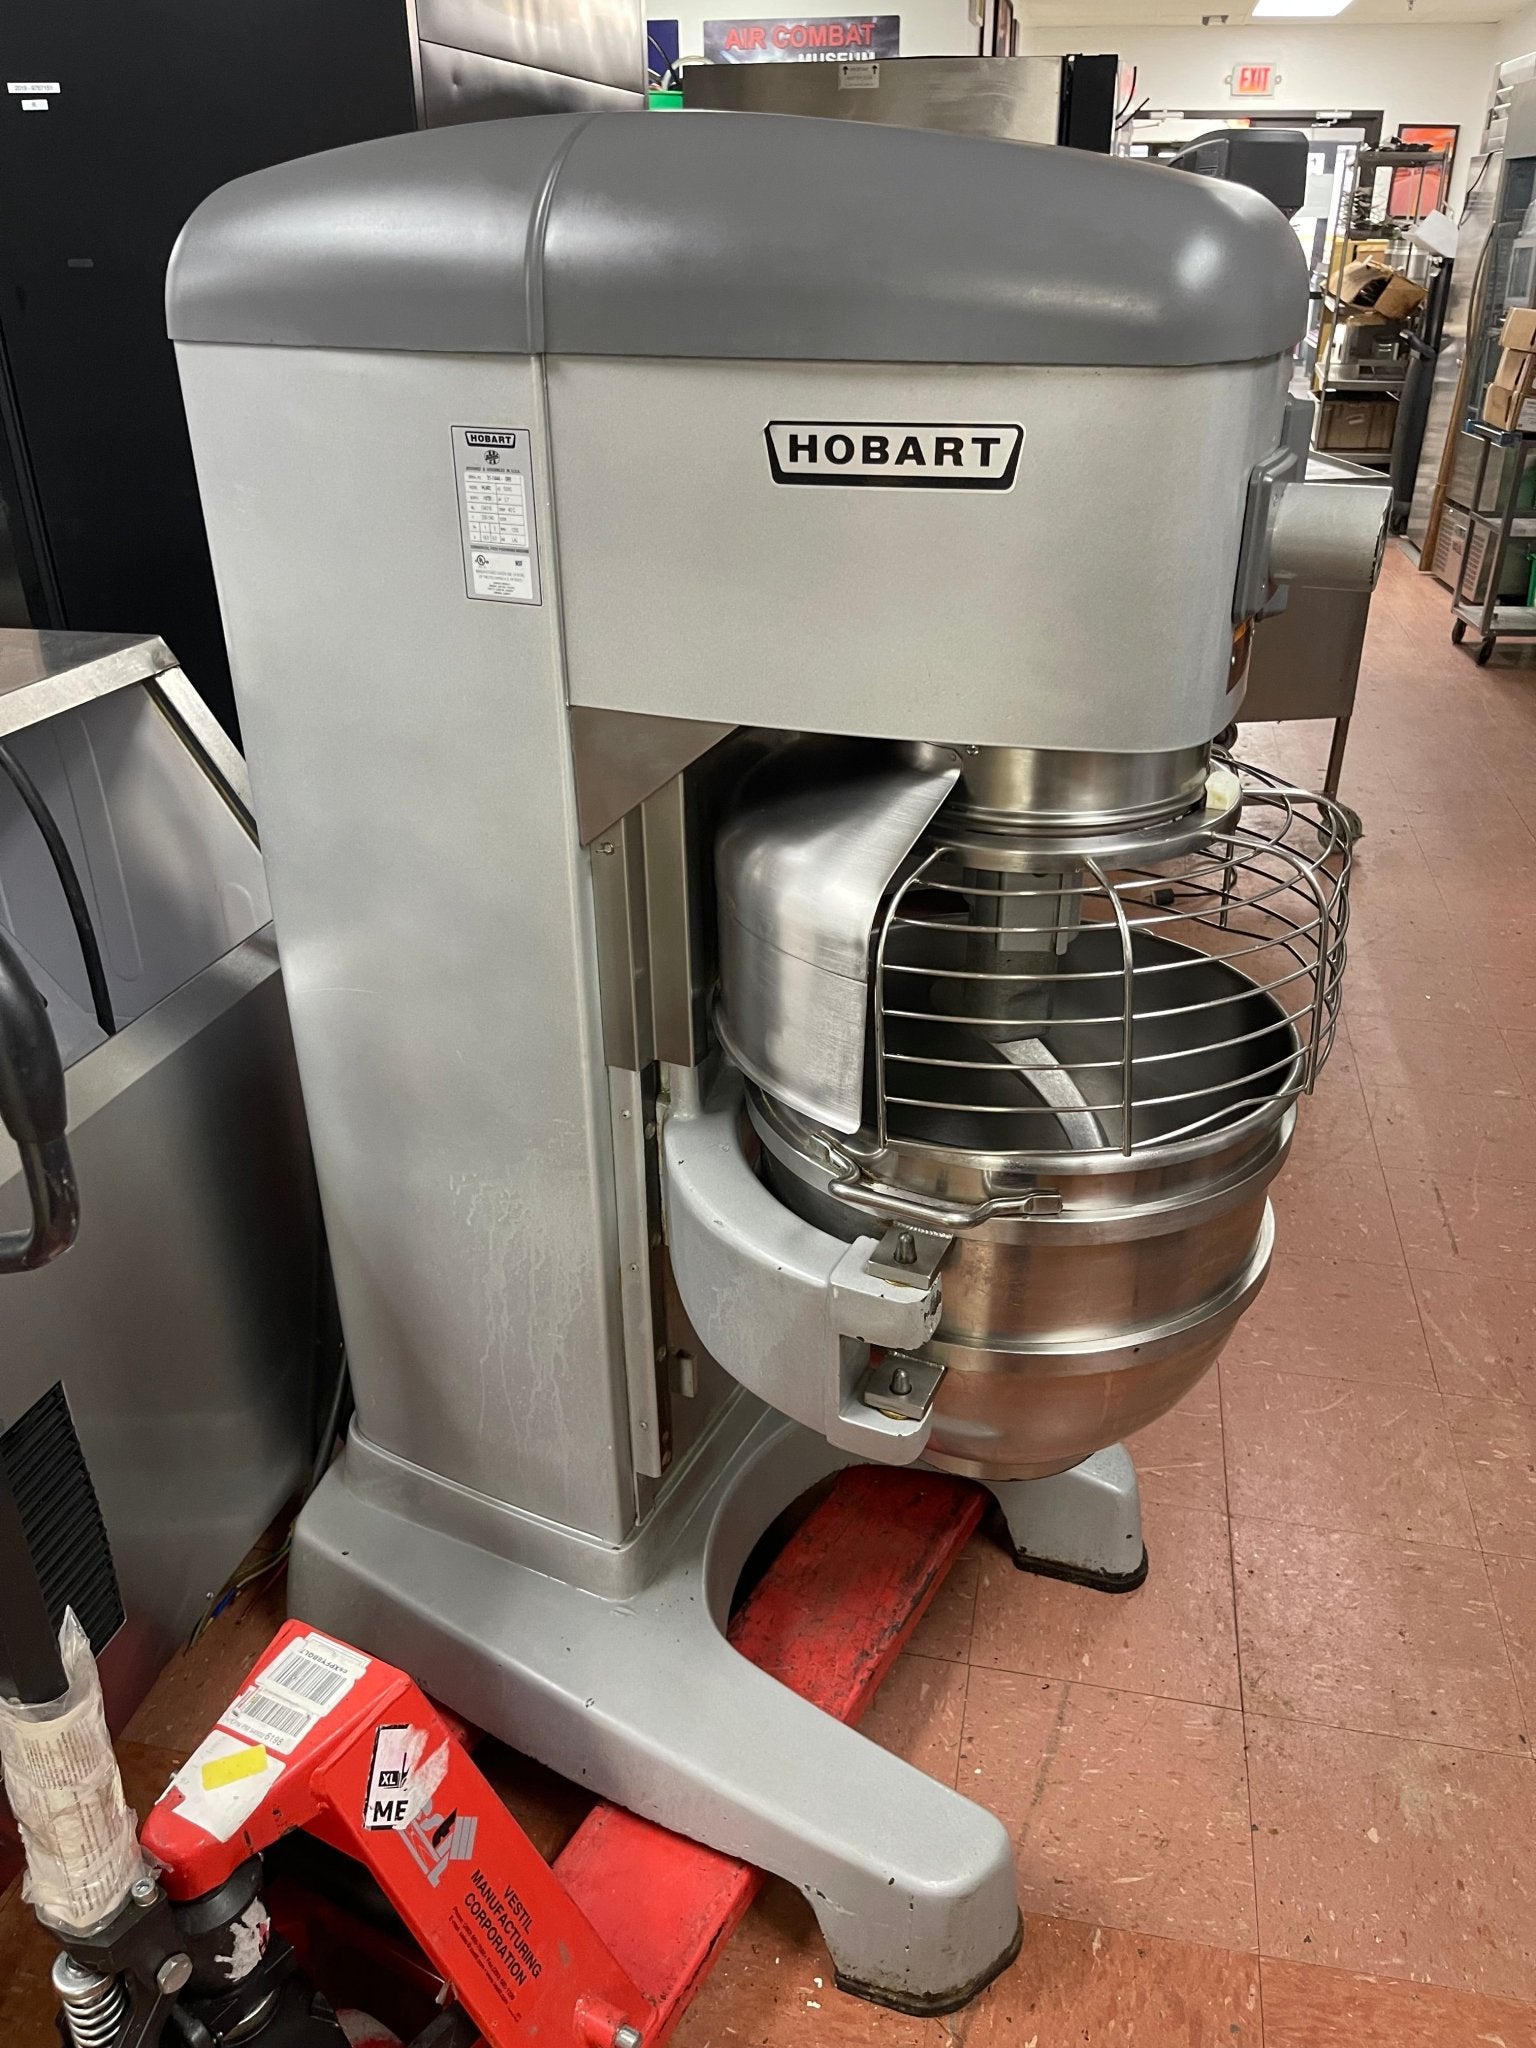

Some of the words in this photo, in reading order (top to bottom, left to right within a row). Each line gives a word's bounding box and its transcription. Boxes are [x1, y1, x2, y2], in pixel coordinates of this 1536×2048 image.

[725, 27, 766, 49] AIR
[772, 22, 875, 48] COMBAT
[798, 52, 876, 62] MUSEUM
[1239, 67, 1271, 92] EXIT
[470, 434, 512, 444] HOBART
[789, 434, 1001, 467] HOBART
[381, 1773, 396, 1785] XL
[503, 1885, 533, 1935] VESTIL
[470, 1868, 542, 1980] MANUFACTURING
[464, 1892, 527, 1987] CORPORATION
